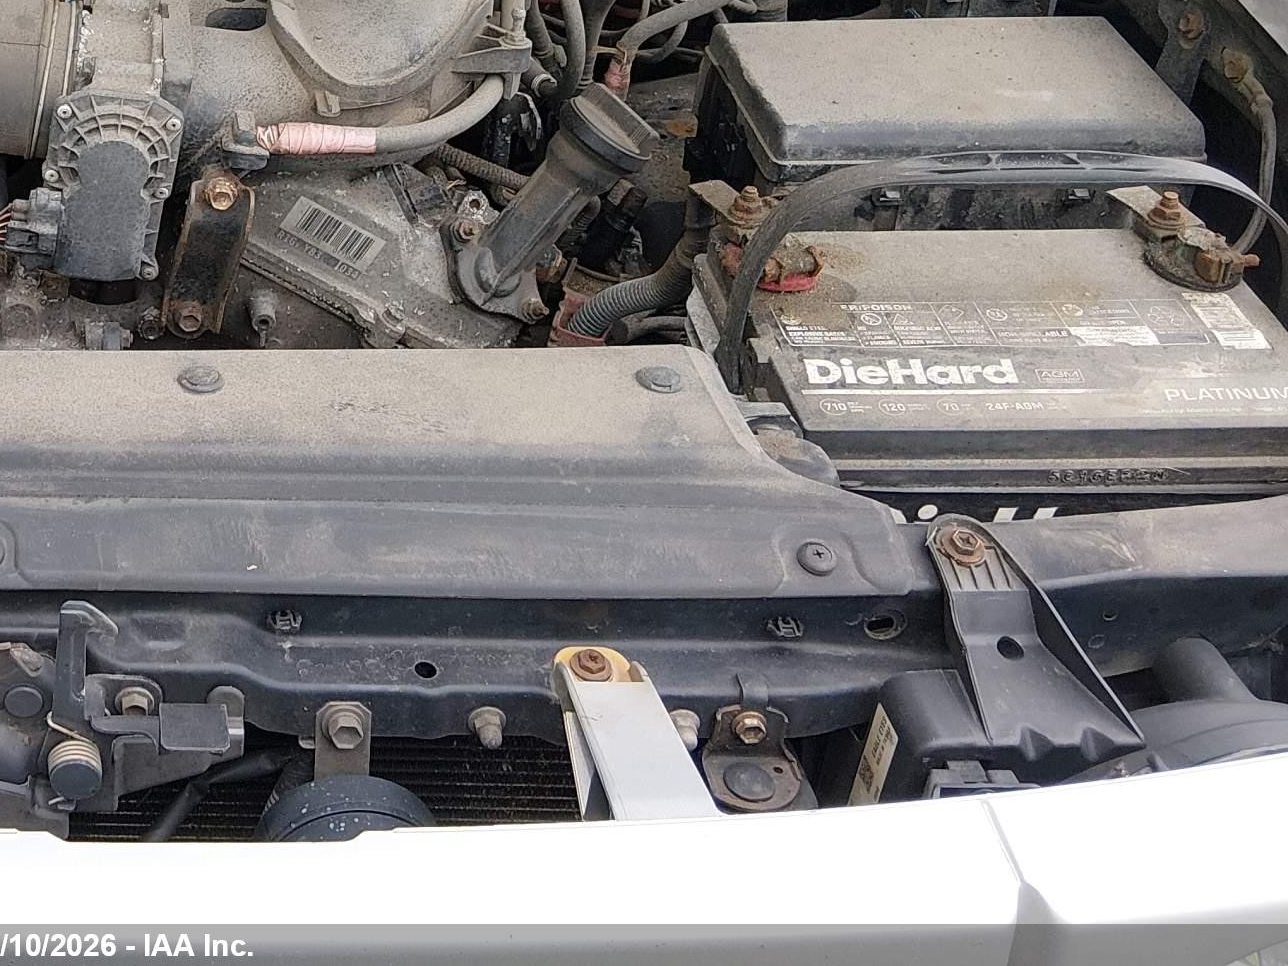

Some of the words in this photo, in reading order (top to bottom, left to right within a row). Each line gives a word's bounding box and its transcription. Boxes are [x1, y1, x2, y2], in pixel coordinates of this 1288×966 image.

[802, 357, 1020, 385] DieHard
[1164, 387, 1288, 401] PLATINUM
[824, 402, 848, 411] 710
[882, 402, 907, 412] 120
[943, 402, 960, 412] 70
